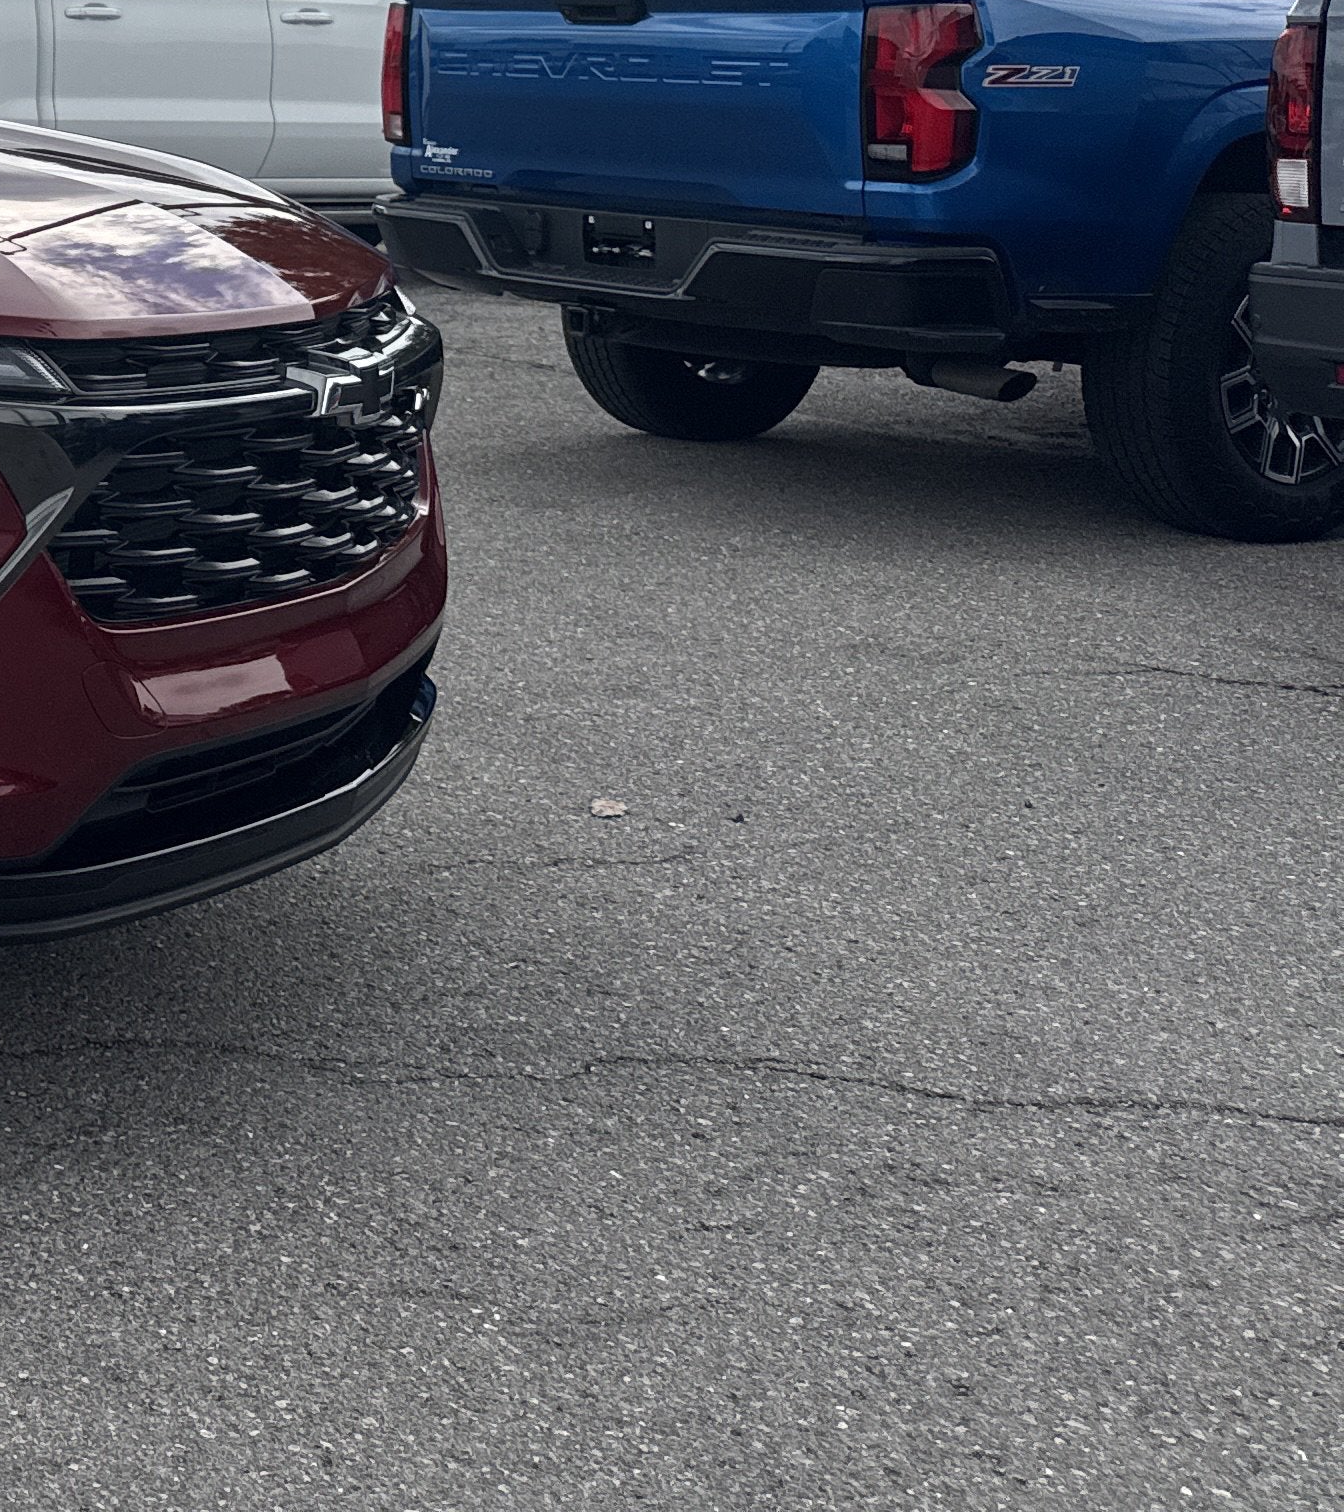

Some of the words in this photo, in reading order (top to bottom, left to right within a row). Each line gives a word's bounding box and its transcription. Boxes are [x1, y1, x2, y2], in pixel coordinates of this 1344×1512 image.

[436, 51, 790, 87] CHEVROLET
[982, 65, 1080, 87] Z71
[419, 164, 493, 178] COLORADO
